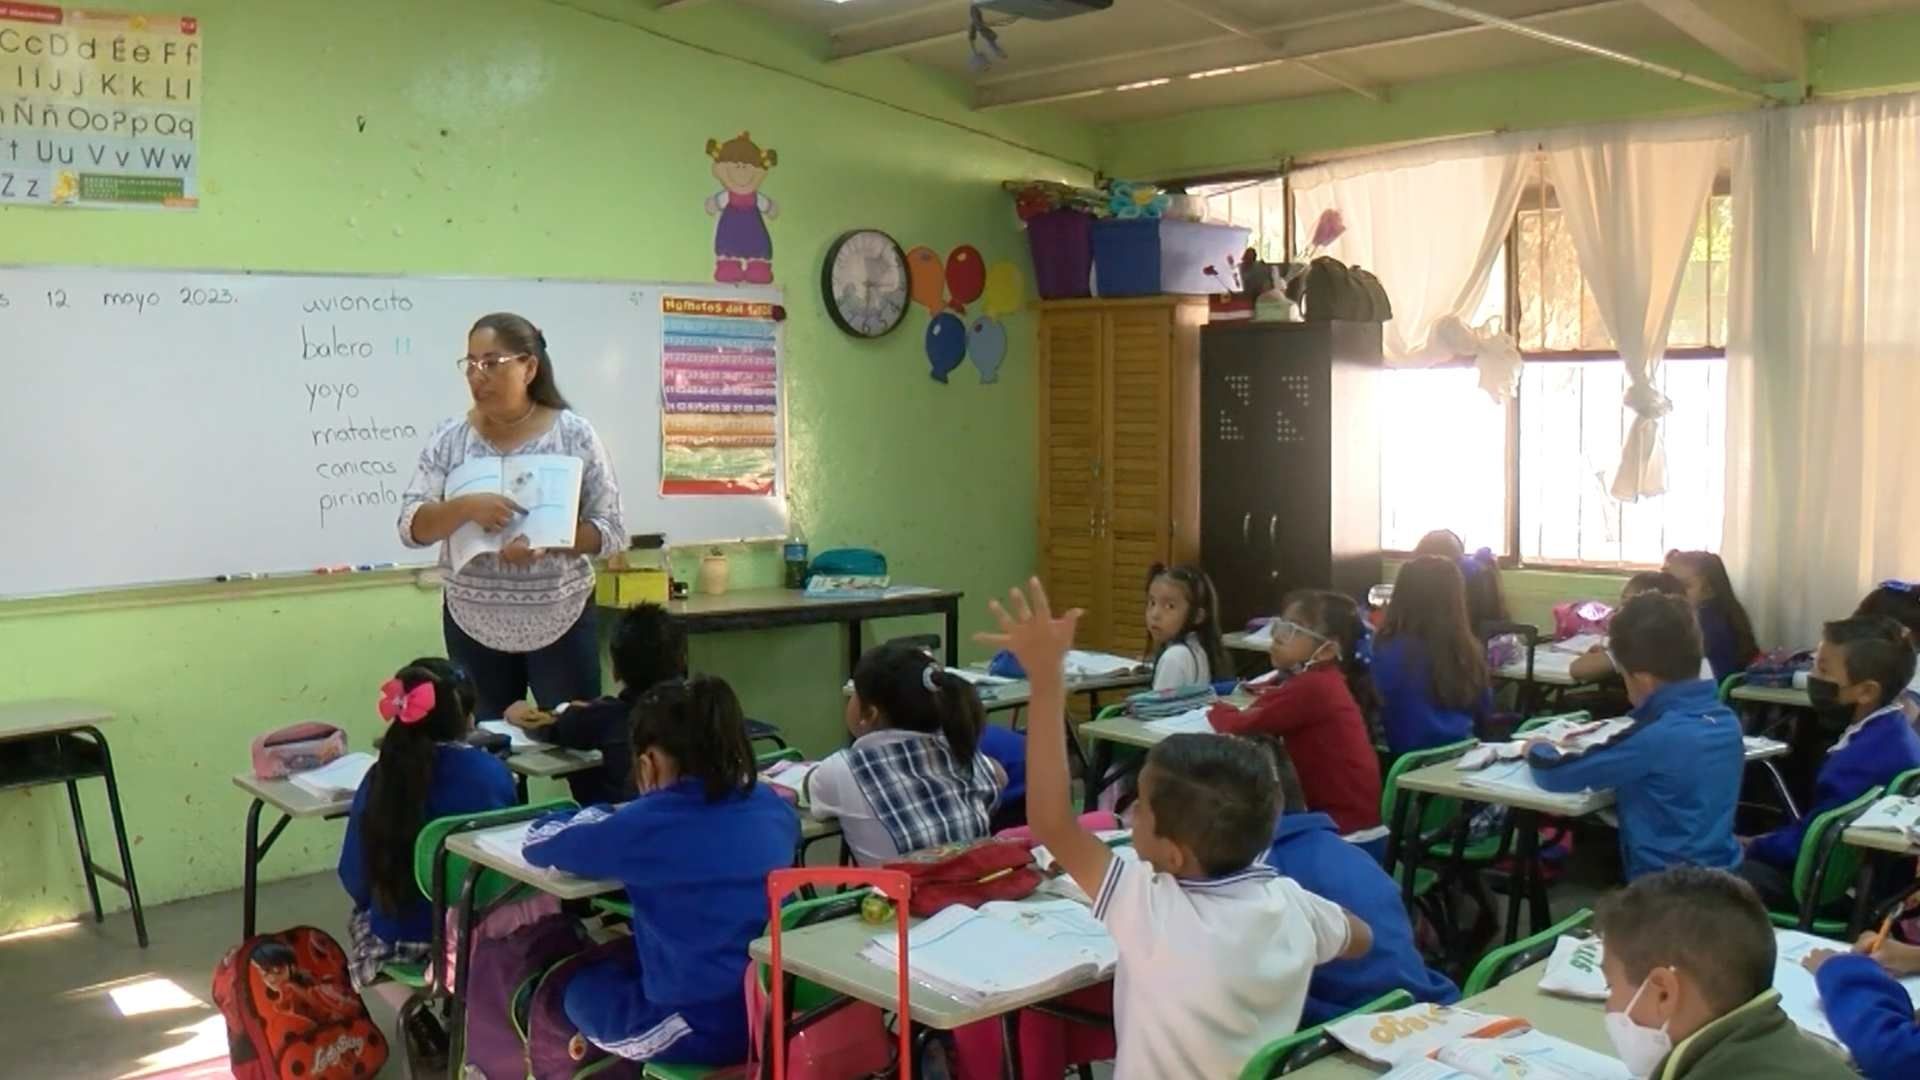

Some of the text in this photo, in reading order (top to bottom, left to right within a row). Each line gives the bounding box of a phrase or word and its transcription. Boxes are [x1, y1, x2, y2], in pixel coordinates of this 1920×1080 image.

[47, 288, 71, 309] 12
[103, 291, 160, 315] mayo
[302, 289, 414, 314] avioncito
[301, 323, 374, 361] balero
[305, 382, 360, 412] yoyo
[311, 415, 418, 447] matatena
[315, 459, 398, 480] canicas
